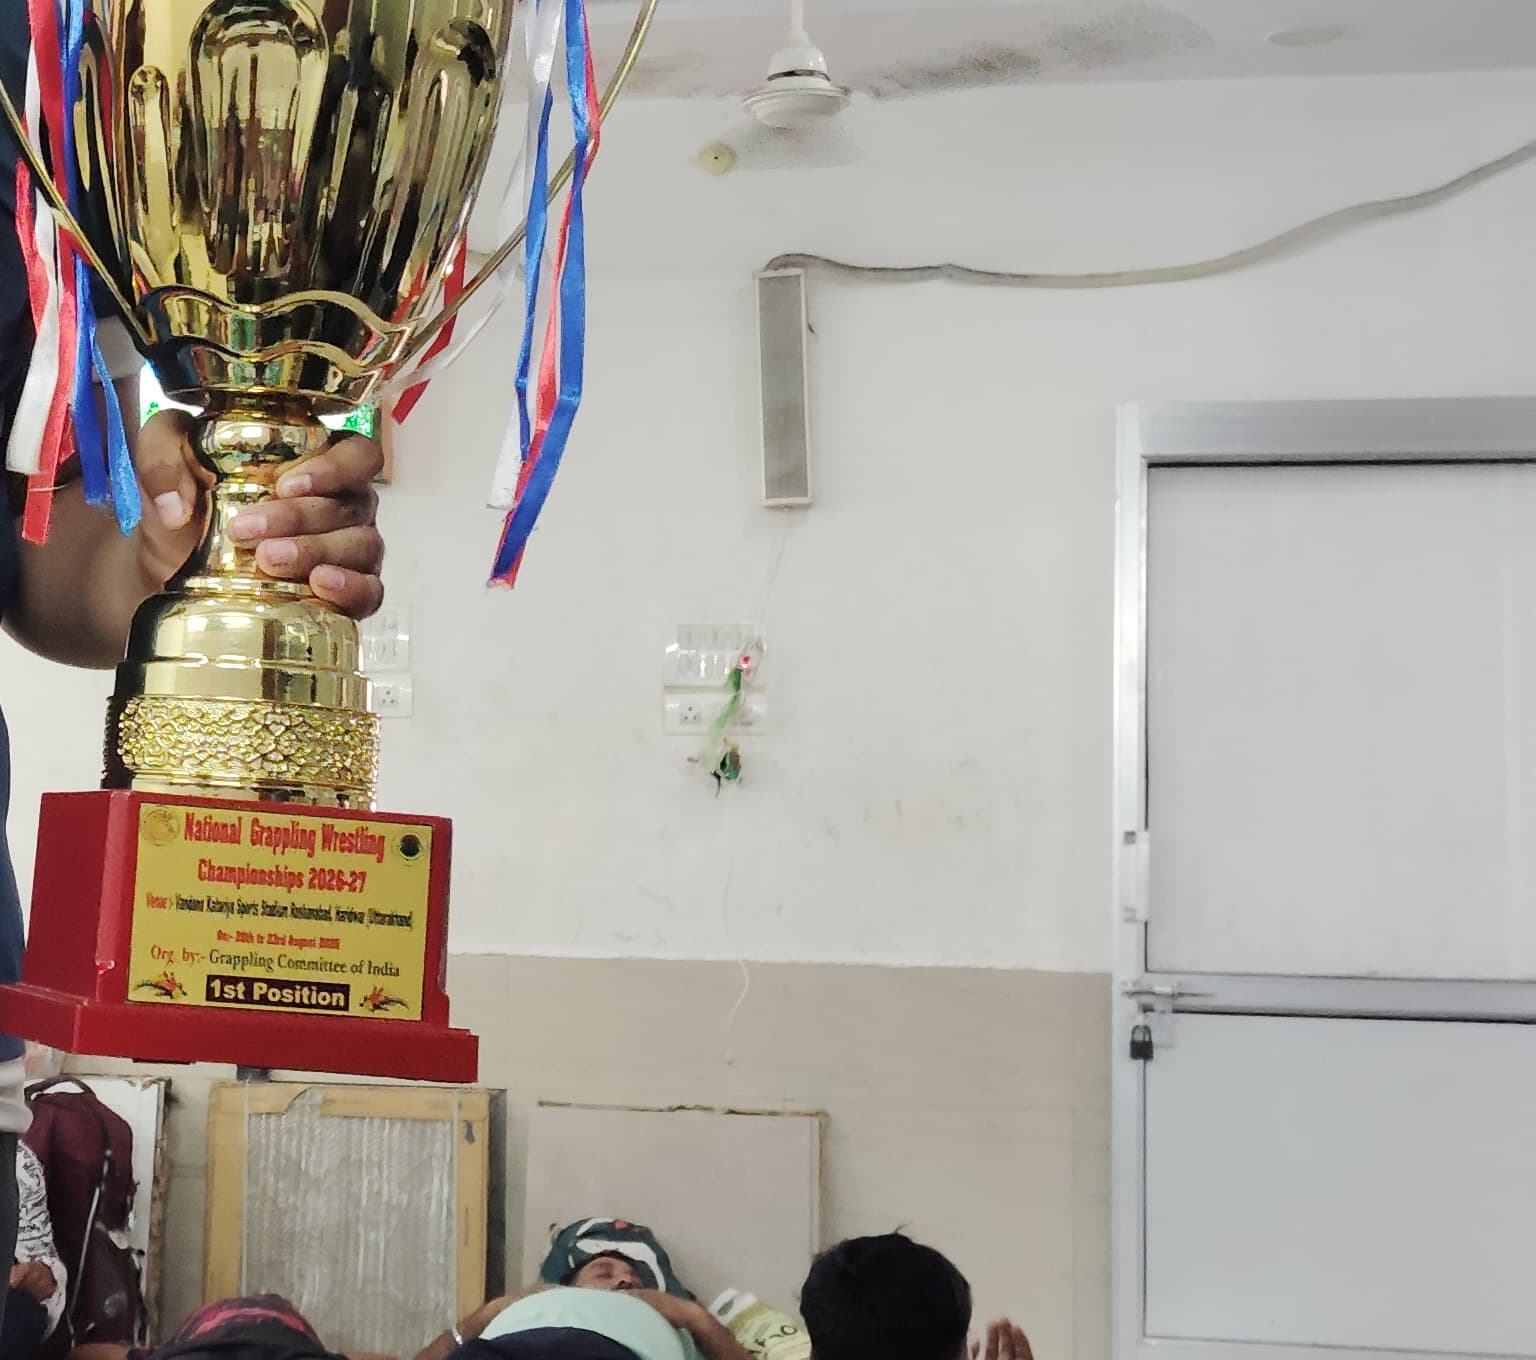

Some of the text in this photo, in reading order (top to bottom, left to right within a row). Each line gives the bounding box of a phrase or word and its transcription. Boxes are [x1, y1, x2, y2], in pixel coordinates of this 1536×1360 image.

[184, 812, 385, 863] National Grappling Wrestling
[198, 858, 367, 894] Championships 2026-27
[209, 949, 274, 973] Grappling
[278, 954, 347, 973] Committee
[350, 960, 365, 974] of
[367, 960, 400, 977] India
[209, 979, 345, 1007] 1st Position
